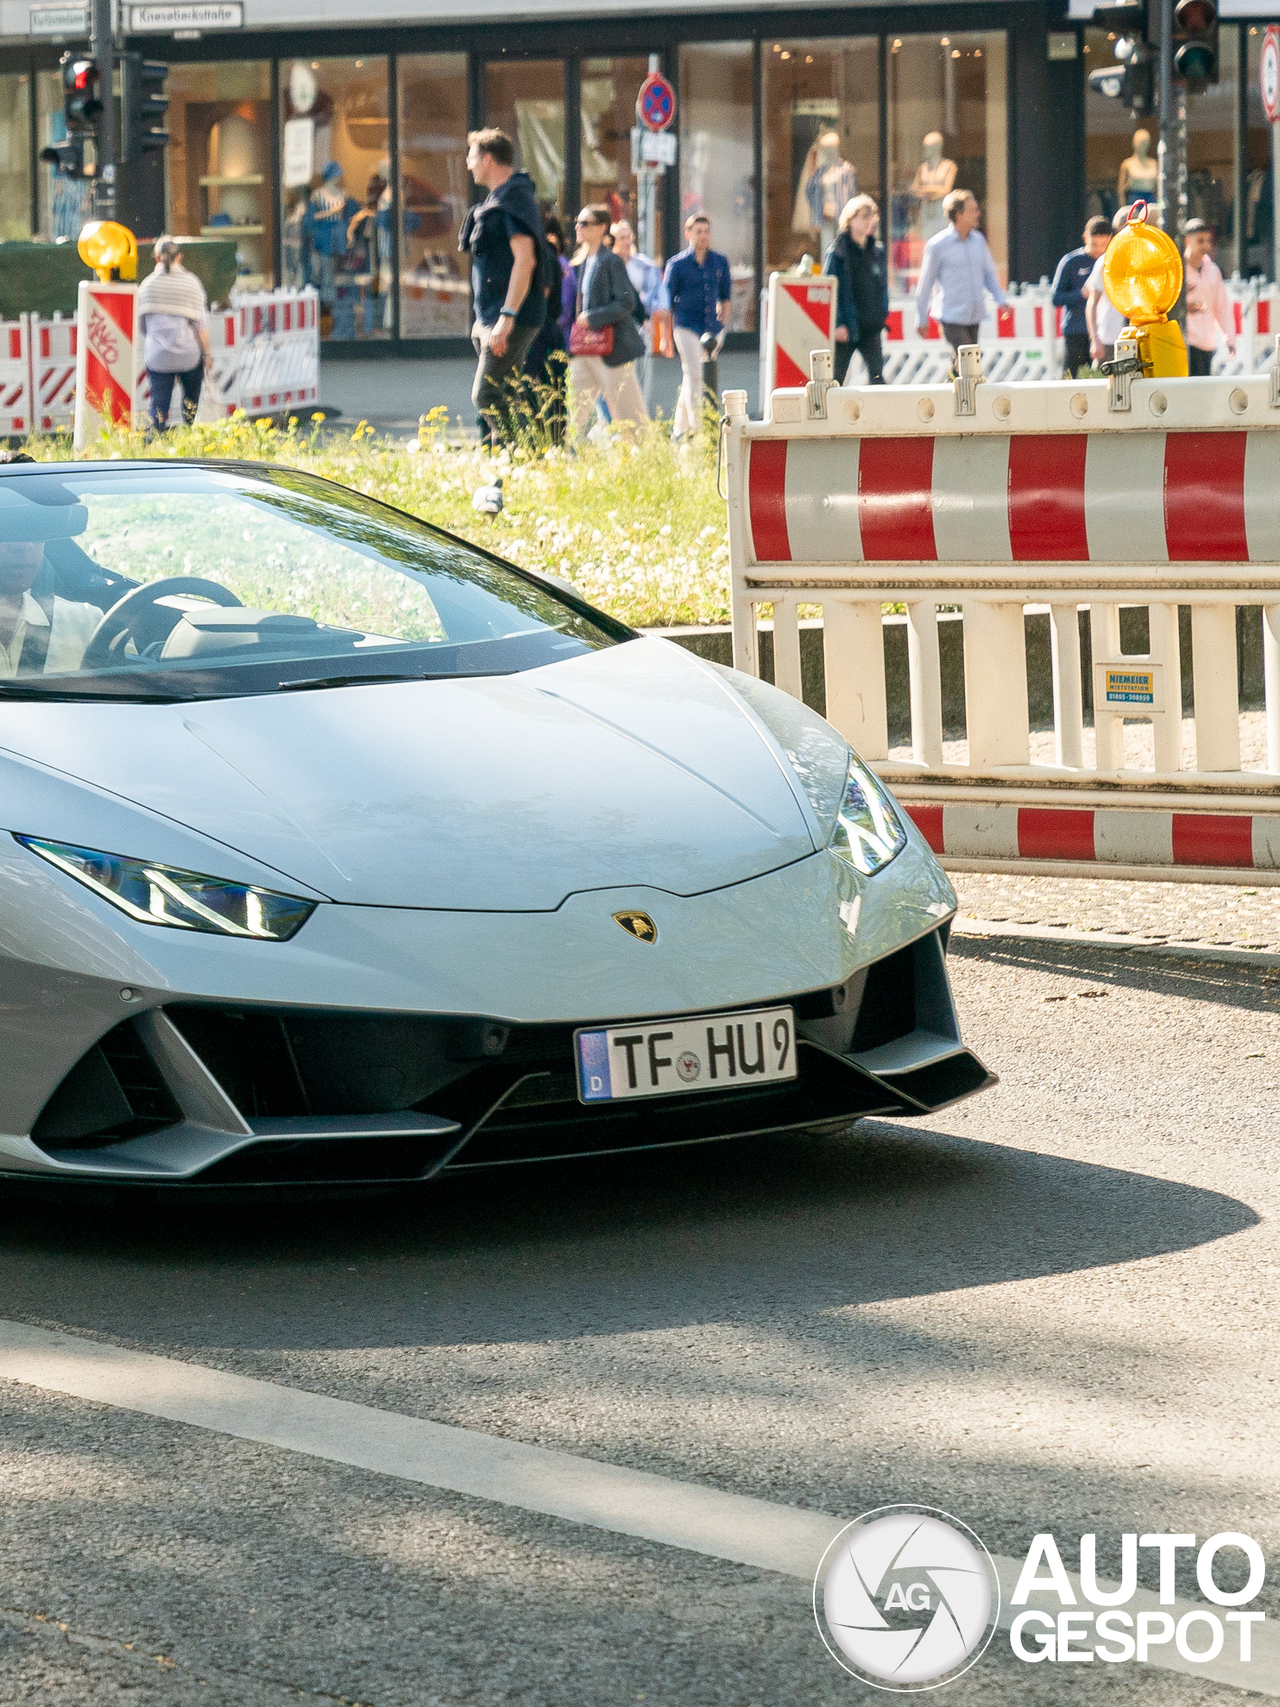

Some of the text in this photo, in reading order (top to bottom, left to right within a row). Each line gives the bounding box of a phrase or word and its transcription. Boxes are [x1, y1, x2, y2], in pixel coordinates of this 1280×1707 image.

[1109, 674, 1149, 684] NIEMEIER
[590, 1076, 603, 1091] D
[613, 1031, 673, 1089] TF
